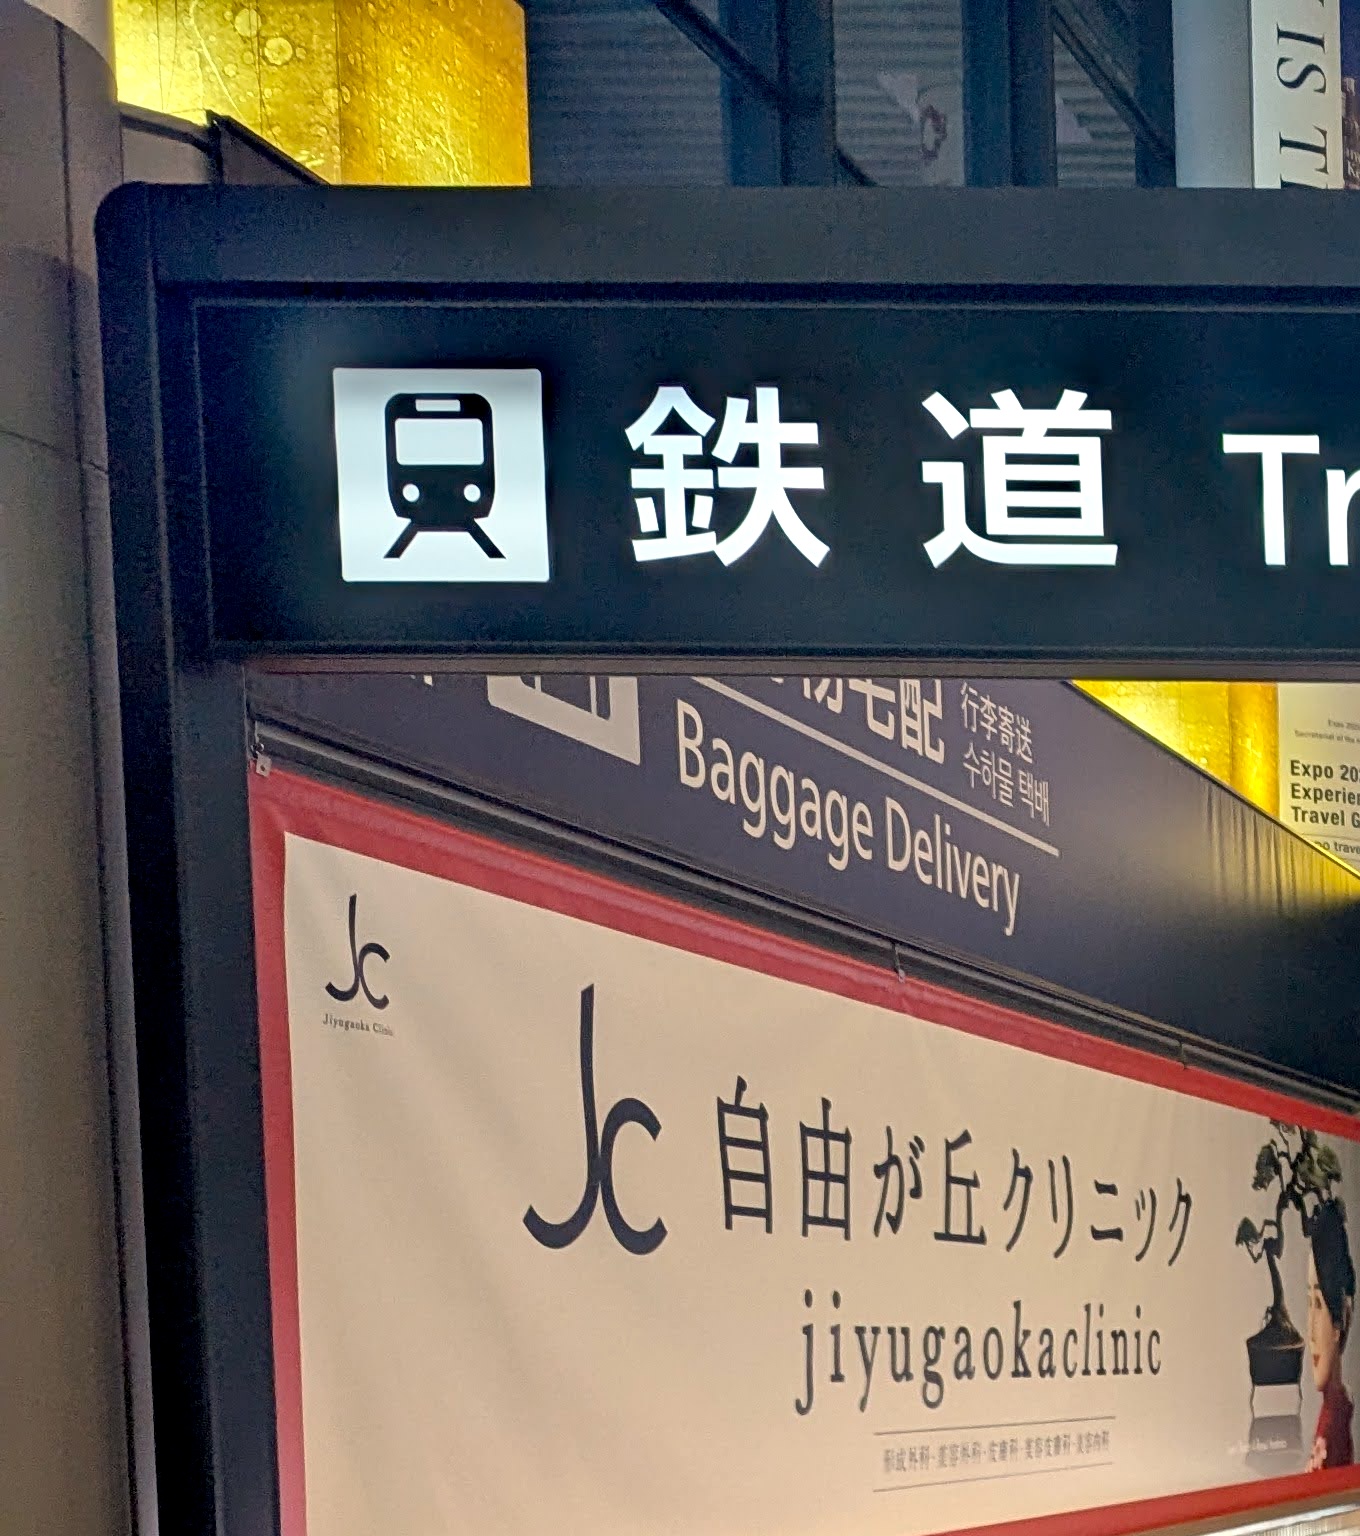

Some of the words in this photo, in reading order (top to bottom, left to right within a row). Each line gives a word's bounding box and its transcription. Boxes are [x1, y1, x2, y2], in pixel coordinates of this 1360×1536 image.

[626, 385, 1120, 569] 鉄道
[677, 698, 874, 871] Baggage
[885, 796, 1021, 937] Delivery
[962, 742, 1014, 808] 수하물
[1018, 770, 1050, 828] 택배
[1290, 760, 1334, 781] Expo
[1291, 806, 1346, 826] Travel
[716, 1075, 1194, 1266] 自由が丘クリニック
[794, 1288, 1163, 1417] jiyugaokaclinic
